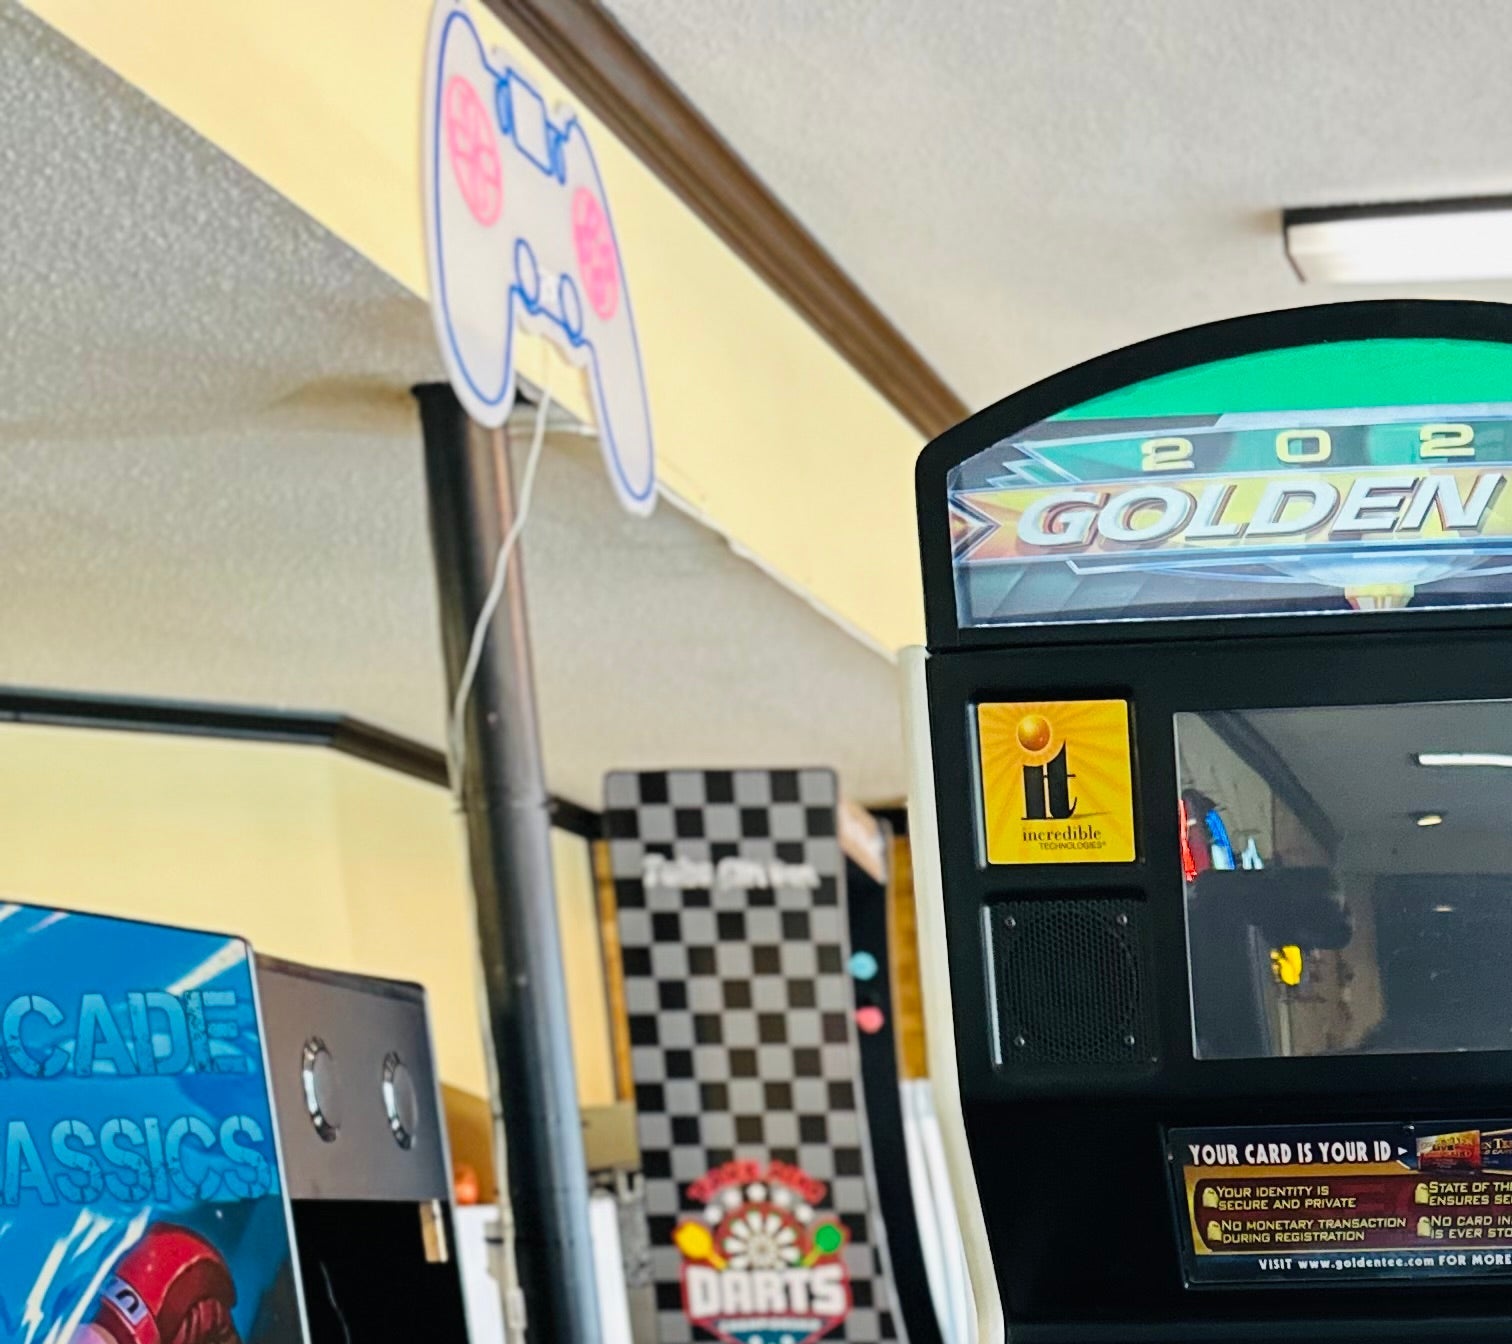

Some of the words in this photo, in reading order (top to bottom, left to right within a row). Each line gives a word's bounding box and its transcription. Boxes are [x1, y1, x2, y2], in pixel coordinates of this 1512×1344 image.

[1017, 472, 1508, 548] GOLDEN
[1022, 824, 1102, 843] incredible
[0, 990, 252, 1080] CADE
[1188, 1143, 1240, 1166] YOUR
[1244, 1143, 1292, 1165] CARD
[1297, 1142, 1313, 1164] IS
[1318, 1141, 1367, 1163] YOUR
[1373, 1140, 1392, 1162] ID
[1217, 1186, 1251, 1198] YOUR
[1256, 1185, 1312, 1198] IDENTITY
[1317, 1185, 1329, 1196] IS
[1429, 1181, 1468, 1194] STATE
[1472, 1181, 1490, 1193] OF
[1218, 1199, 1269, 1211] SECURE
[1273, 1199, 1300, 1210] AND
[1305, 1197, 1357, 1209] PRIVATE
[1429, 1195, 1490, 1206] ENSURES
[1221, 1219, 1242, 1231] NO
[1246, 1219, 1315, 1231] MONETARY
[1318, 1217, 1407, 1229] TRANSACTION
[1431, 1215, 1452, 1228] NO
[1456, 1215, 1493, 1227] CARD
[1222, 1232, 1271, 1244] DURING
[1275, 1231, 1365, 1243] REGISTRATION
[1430, 1229, 1444, 1239] IS
[1449, 1228, 1482, 1239] EVER
[1258, 1258, 1293, 1270] VISIT
[1298, 1256, 1435, 1270] www.goldentee.com
[1438, 1254, 1467, 1266] FOR
[1471, 1253, 1512, 1265] MORE
[685, 1262, 847, 1319] DARTS
